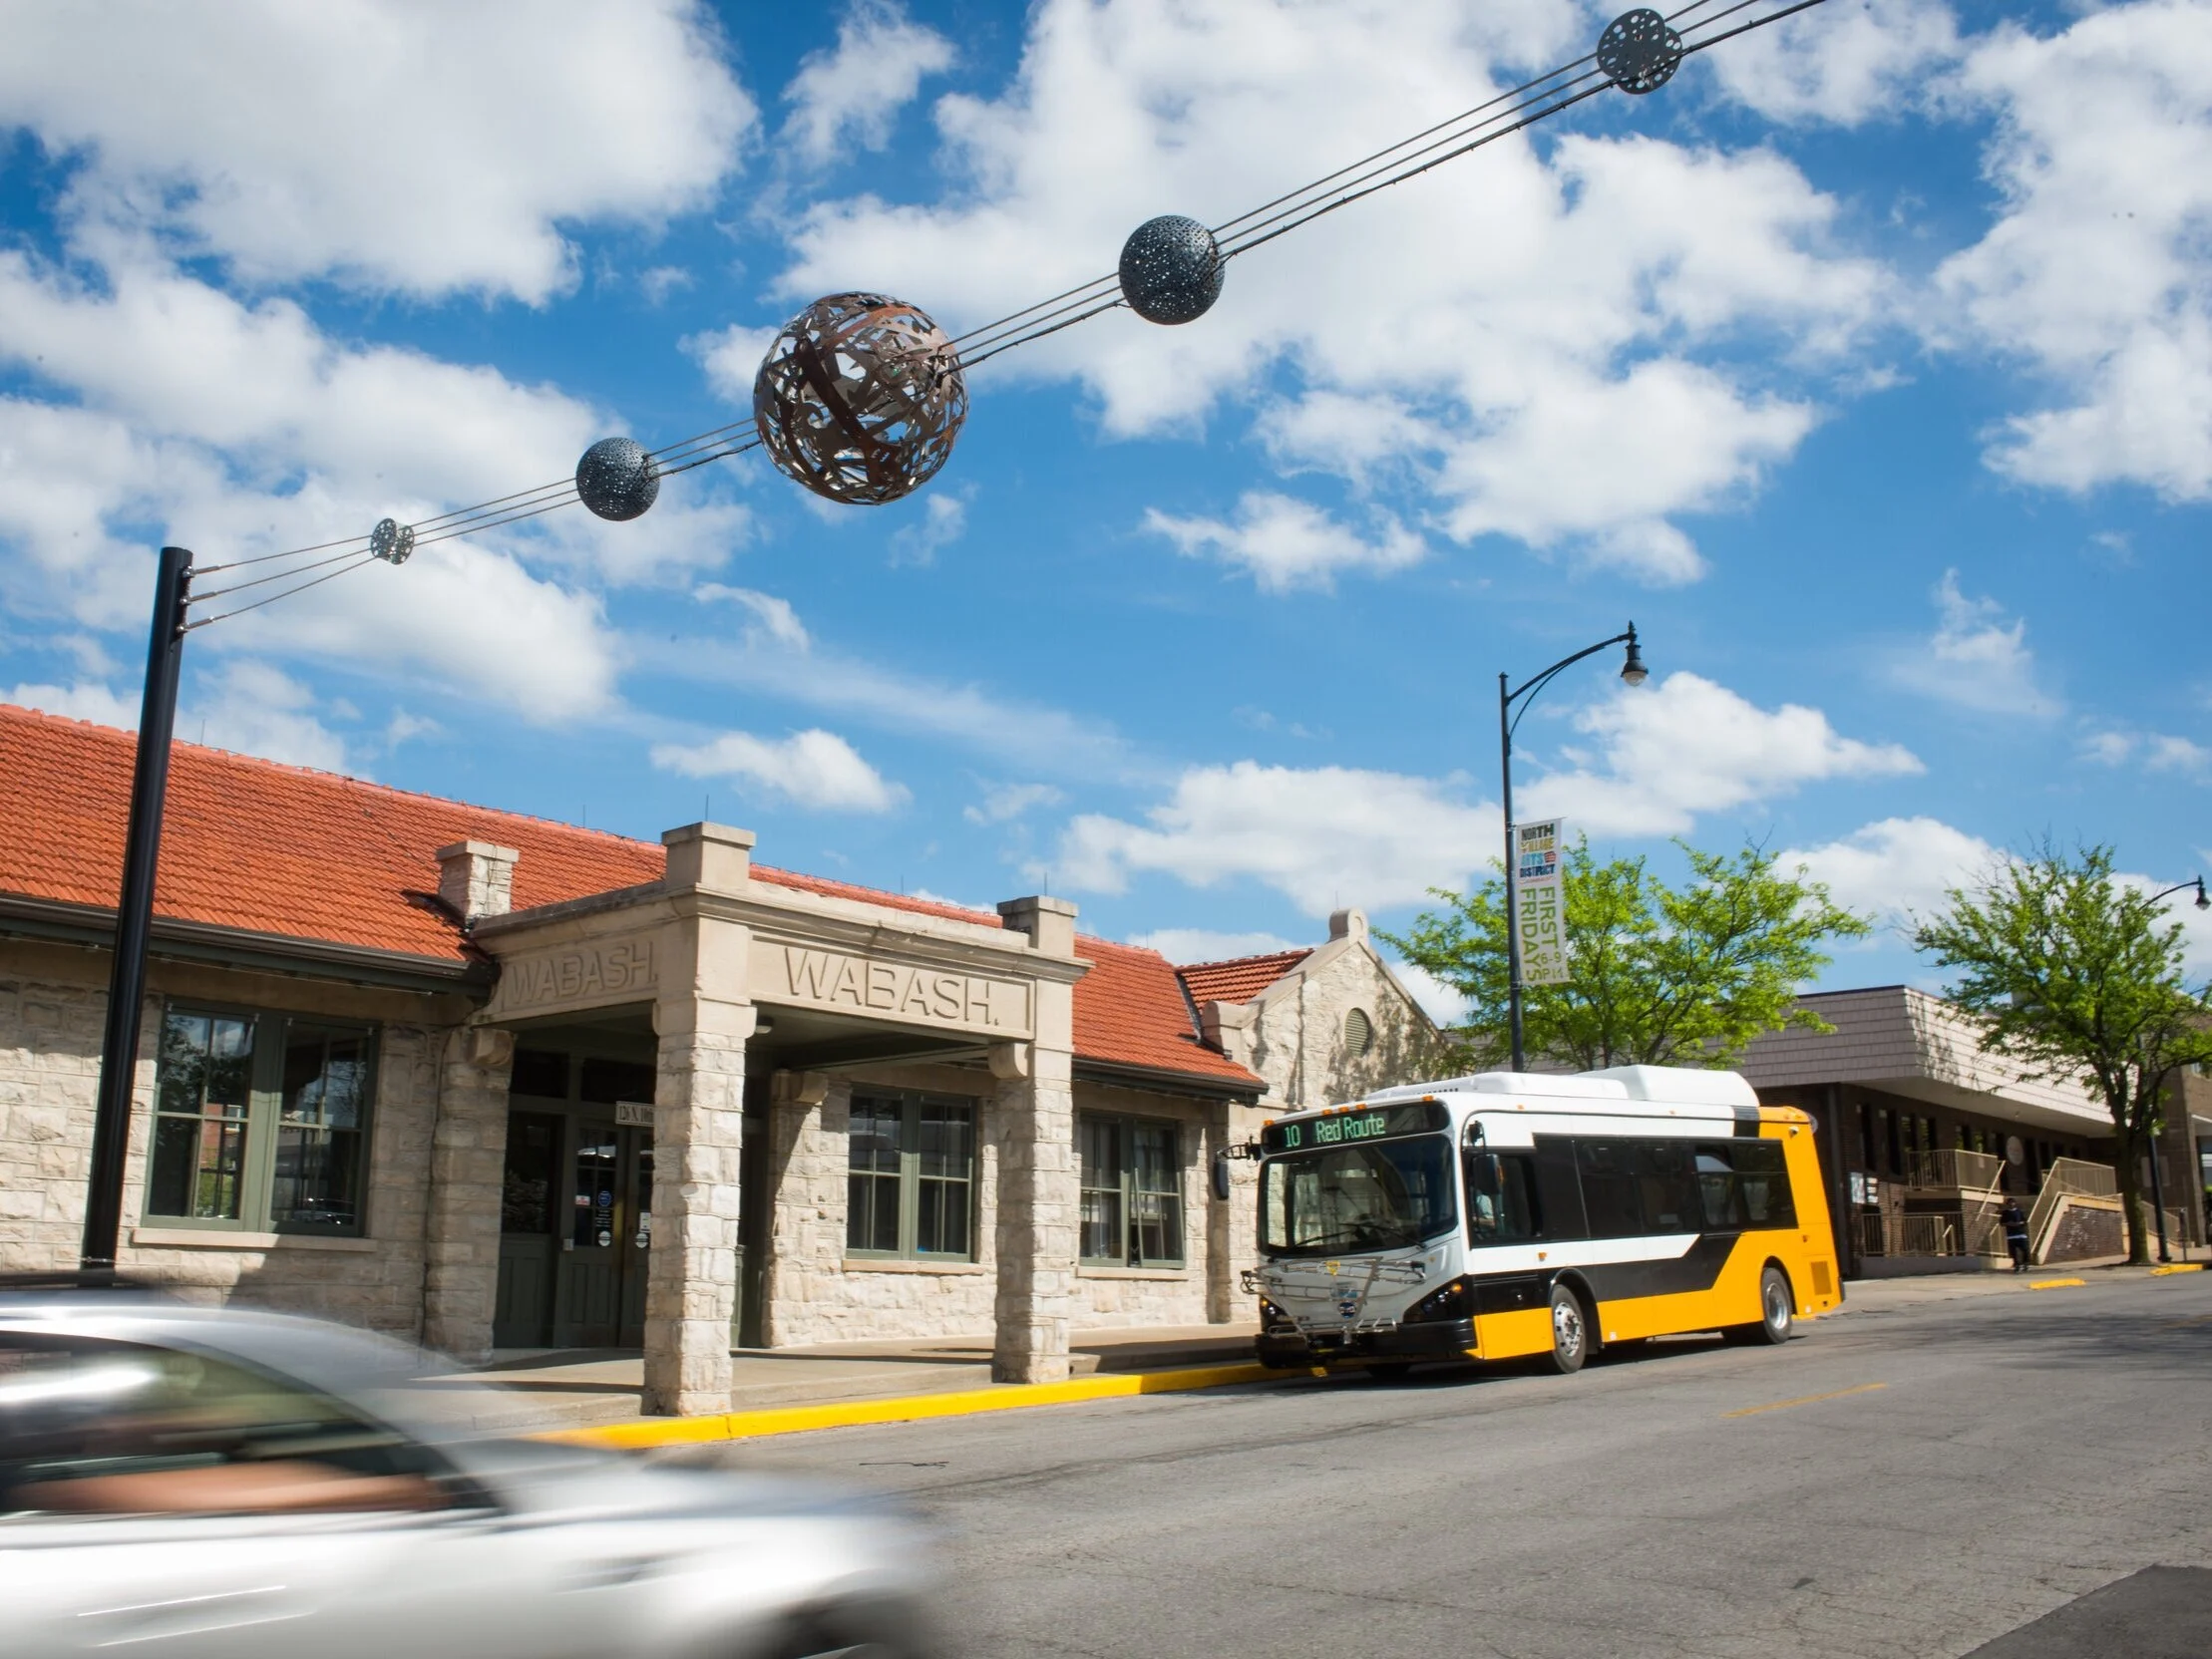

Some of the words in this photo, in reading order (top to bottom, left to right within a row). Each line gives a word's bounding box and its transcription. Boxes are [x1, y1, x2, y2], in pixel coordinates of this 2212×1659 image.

[1520, 887, 1543, 982] FRIDAYS
[1539, 886, 1558, 948] FIRST
[1542, 967, 1564, 980] PM
[1284, 1125, 1301, 1148] 10
[1314, 1120, 1340, 1144] Red
[1343, 1114, 1387, 1141] Route
